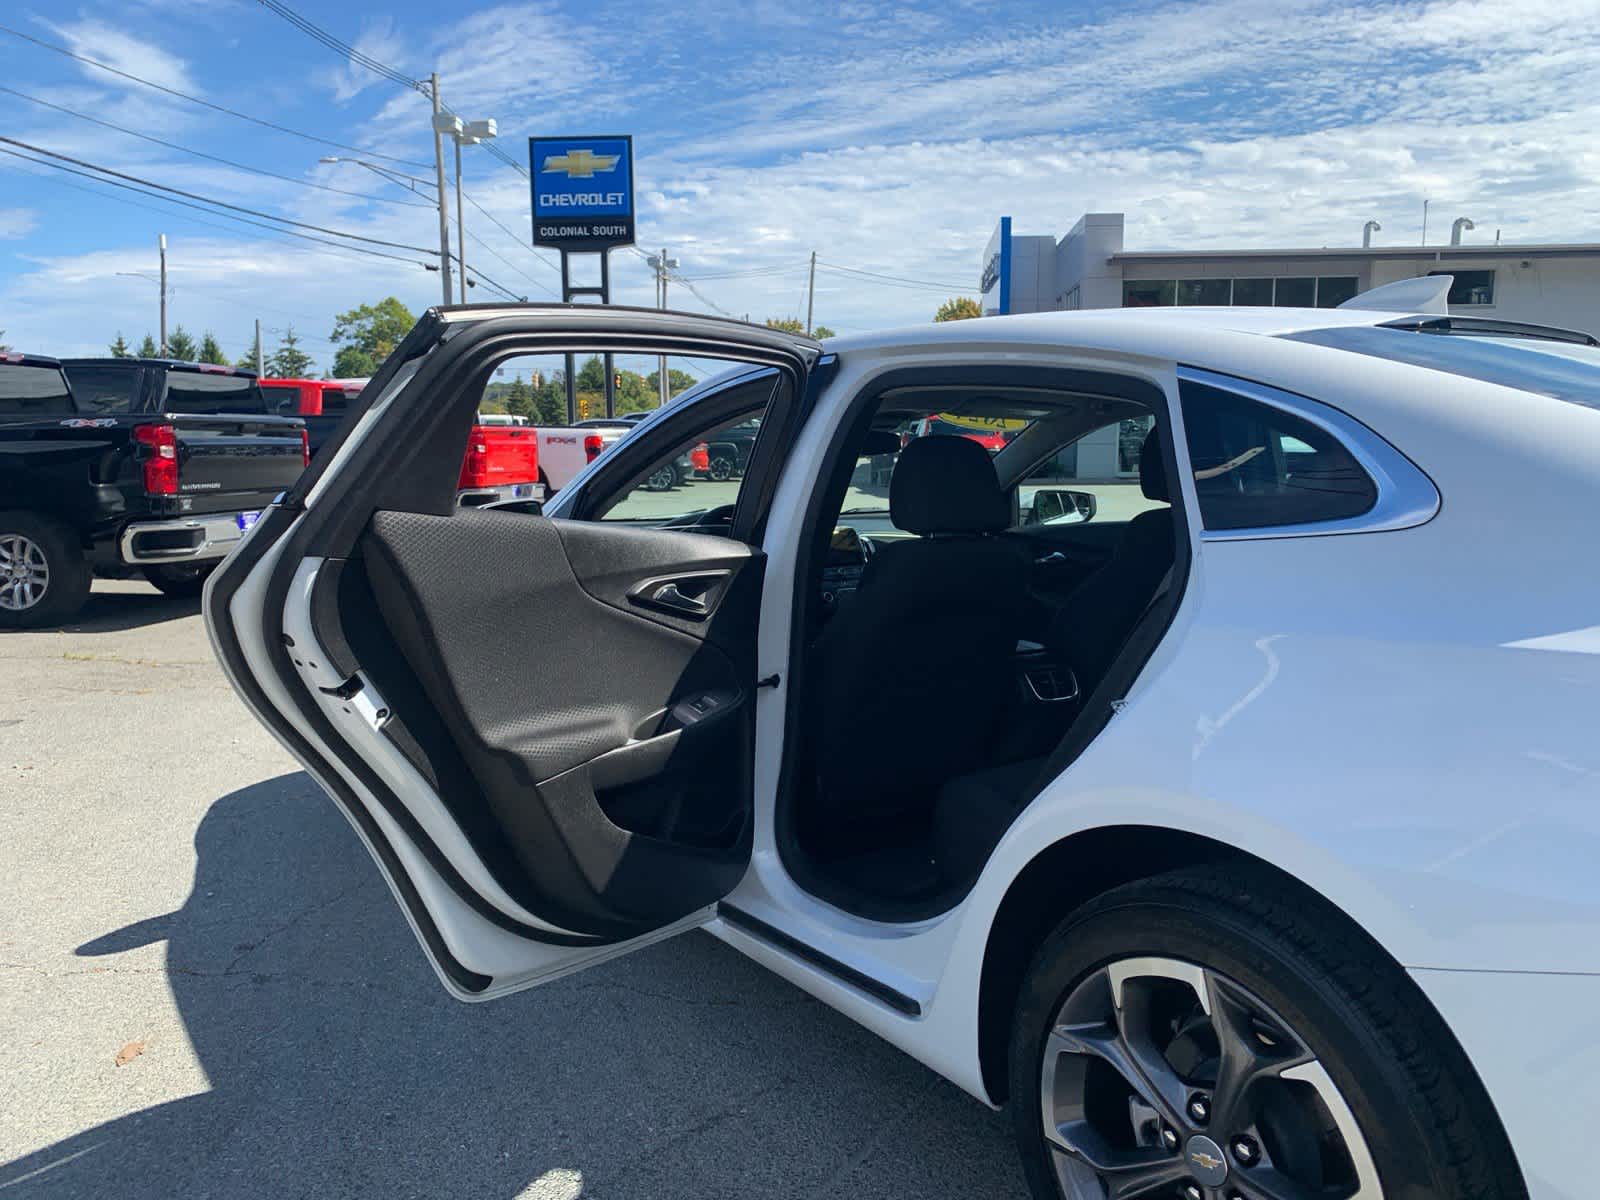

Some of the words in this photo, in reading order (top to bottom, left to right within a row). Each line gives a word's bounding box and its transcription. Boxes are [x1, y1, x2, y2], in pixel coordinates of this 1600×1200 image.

[540, 193, 624, 206] CHEVROLET
[540, 226, 590, 237] COLONIAL
[592, 225, 626, 236] SOUTH
